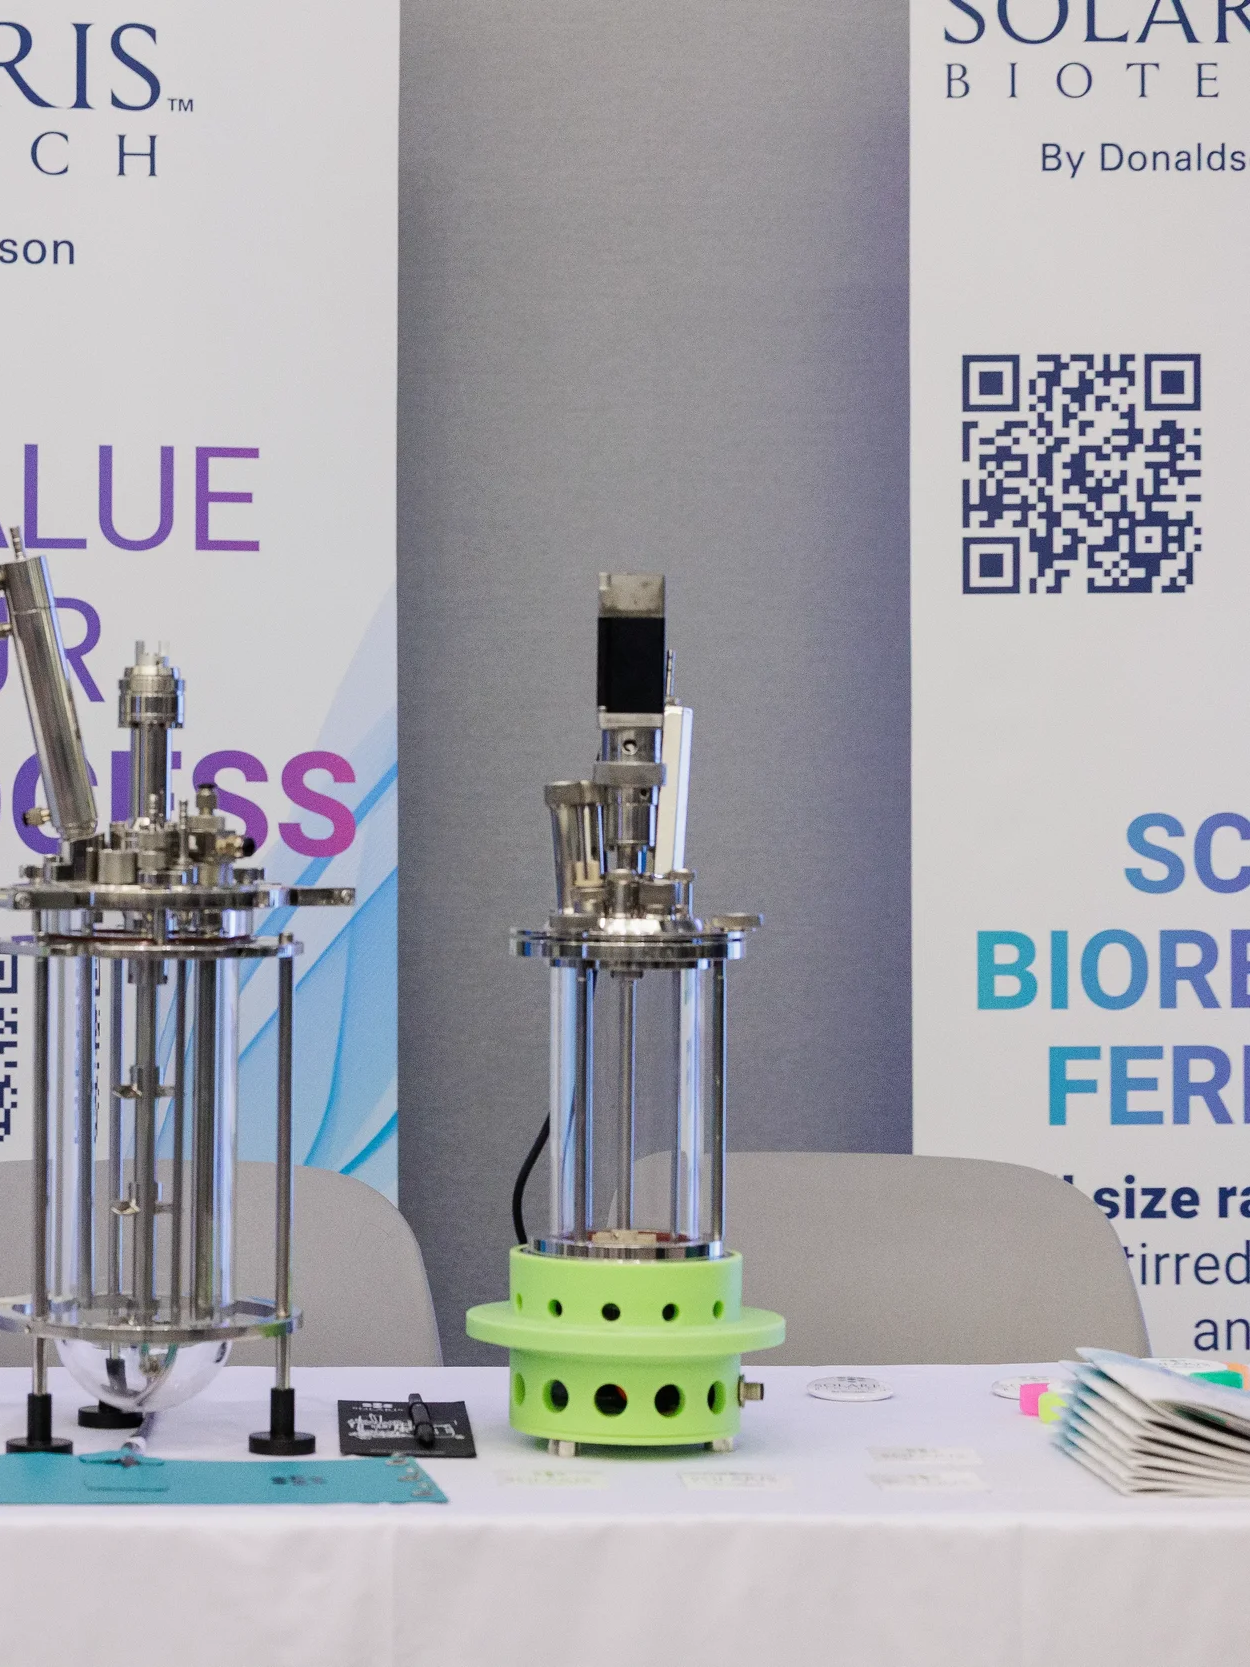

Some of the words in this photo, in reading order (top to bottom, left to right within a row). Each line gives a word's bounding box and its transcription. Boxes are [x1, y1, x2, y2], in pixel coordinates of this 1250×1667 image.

[945, 62, 1220, 98] BIOTE
[1041, 143, 1086, 178] By
[1100, 143, 1250, 172] Donalds
[1124, 812, 1250, 894] SC
[1049, 1045, 1250, 1126] FER
[1093, 1174, 1200, 1219] size
[1123, 1240, 1250, 1285] irred
[1194, 1319, 1250, 1352] an
